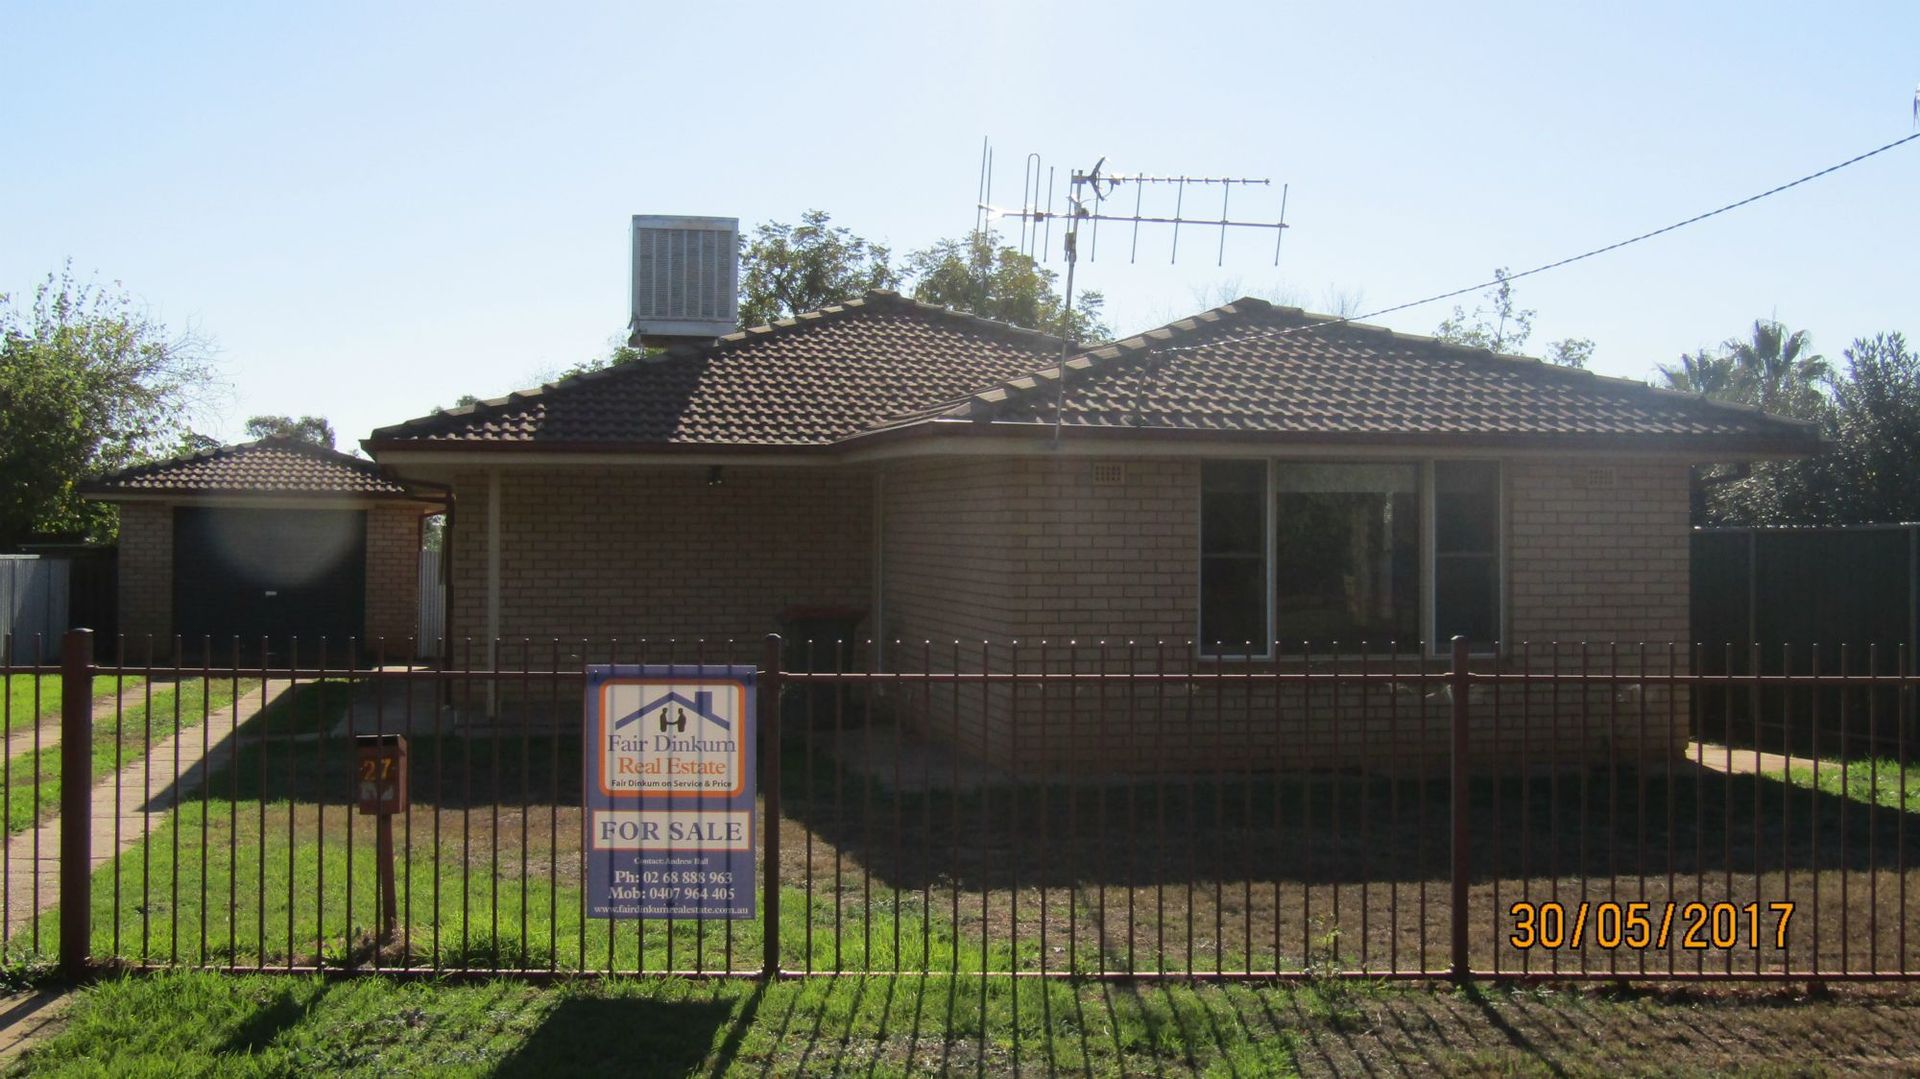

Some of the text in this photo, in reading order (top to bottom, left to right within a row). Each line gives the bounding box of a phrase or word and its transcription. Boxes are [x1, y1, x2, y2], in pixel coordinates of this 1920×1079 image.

[608, 735, 736, 752] Fair Dinkum
[363, 758, 392, 780] 27
[618, 757, 726, 775] Real Estate
[628, 780, 660, 788] Dinkum
[674, 780, 703, 788] Service
[601, 821, 742, 841] FOR SALE
[614, 870, 733, 884] Ph: 02 68 888 963
[608, 887, 735, 900] Mob: 0407 964 405
